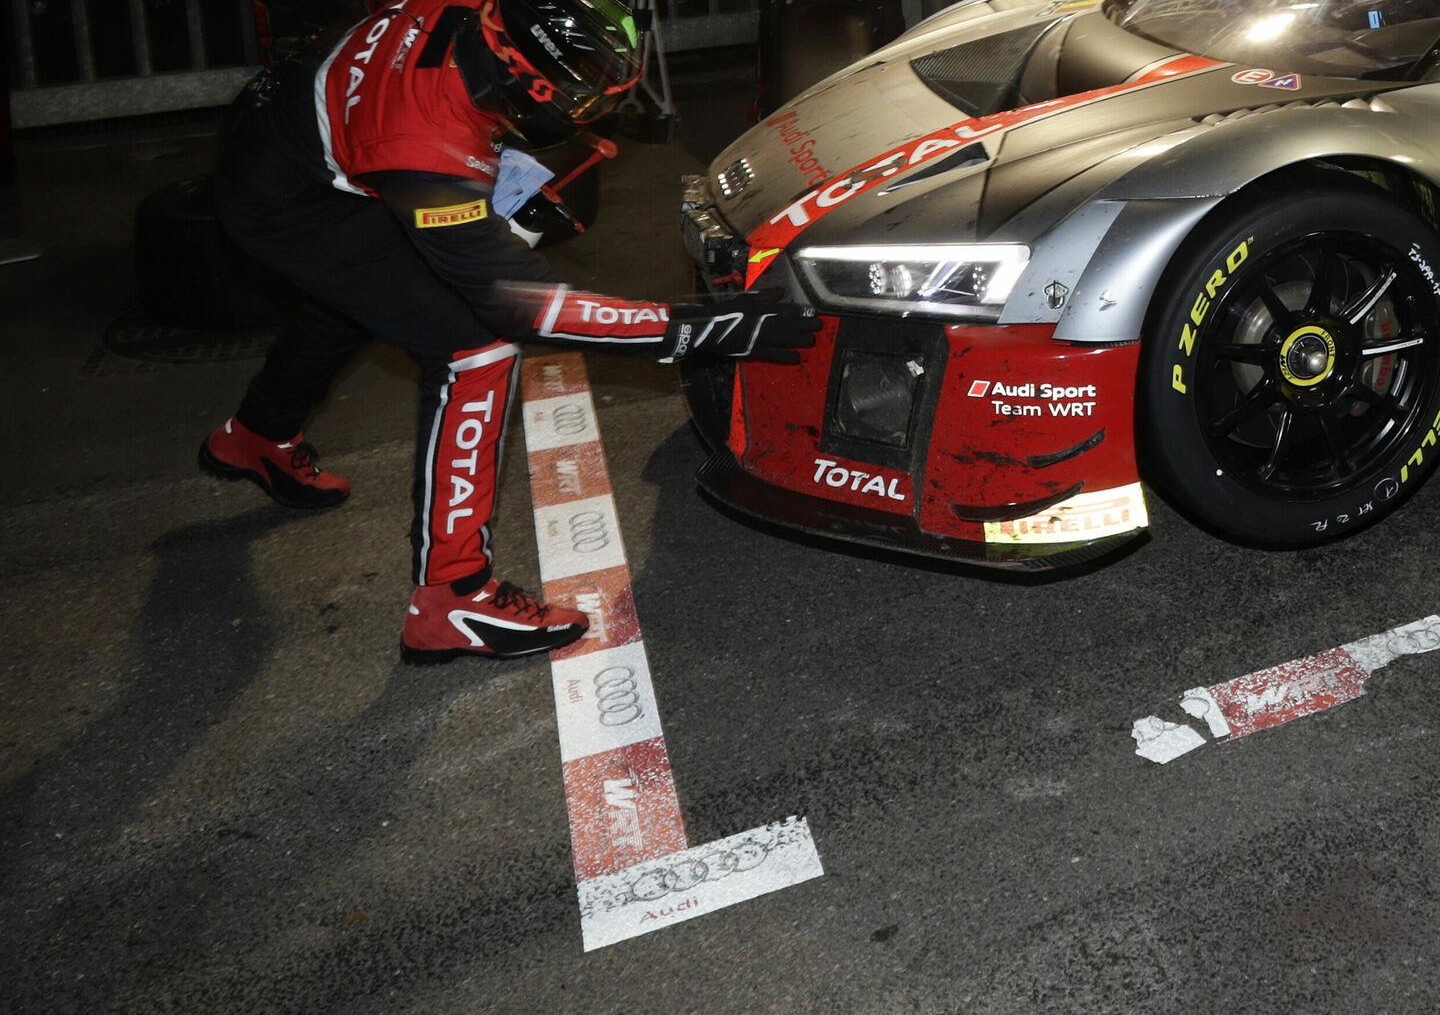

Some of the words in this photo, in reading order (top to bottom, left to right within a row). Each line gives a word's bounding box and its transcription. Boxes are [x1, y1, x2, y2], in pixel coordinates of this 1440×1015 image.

[776, 114, 801, 149] Audi
[770, 120, 1004, 228] TOTAL
[787, 138, 831, 187] Sport
[423, 203, 481, 225] PIRELLI
[576, 299, 669, 325] TOTAL
[1178, 241, 1251, 357] ZERO
[1320, 330, 1336, 357] FRONT
[992, 382, 1035, 398] Audi
[1040, 383, 1096, 400] Sport
[1172, 363, 1187, 394] P
[992, 401, 1042, 417] Team
[1049, 401, 1096, 417] WRT
[447, 391, 495, 535] TOTAL
[556, 459, 581, 497] WRT
[813, 459, 906, 501] TOTAL
[998, 496, 1132, 535] PIRELLI
[567, 679, 584, 704] Audi
[639, 897, 699, 924] Audi
